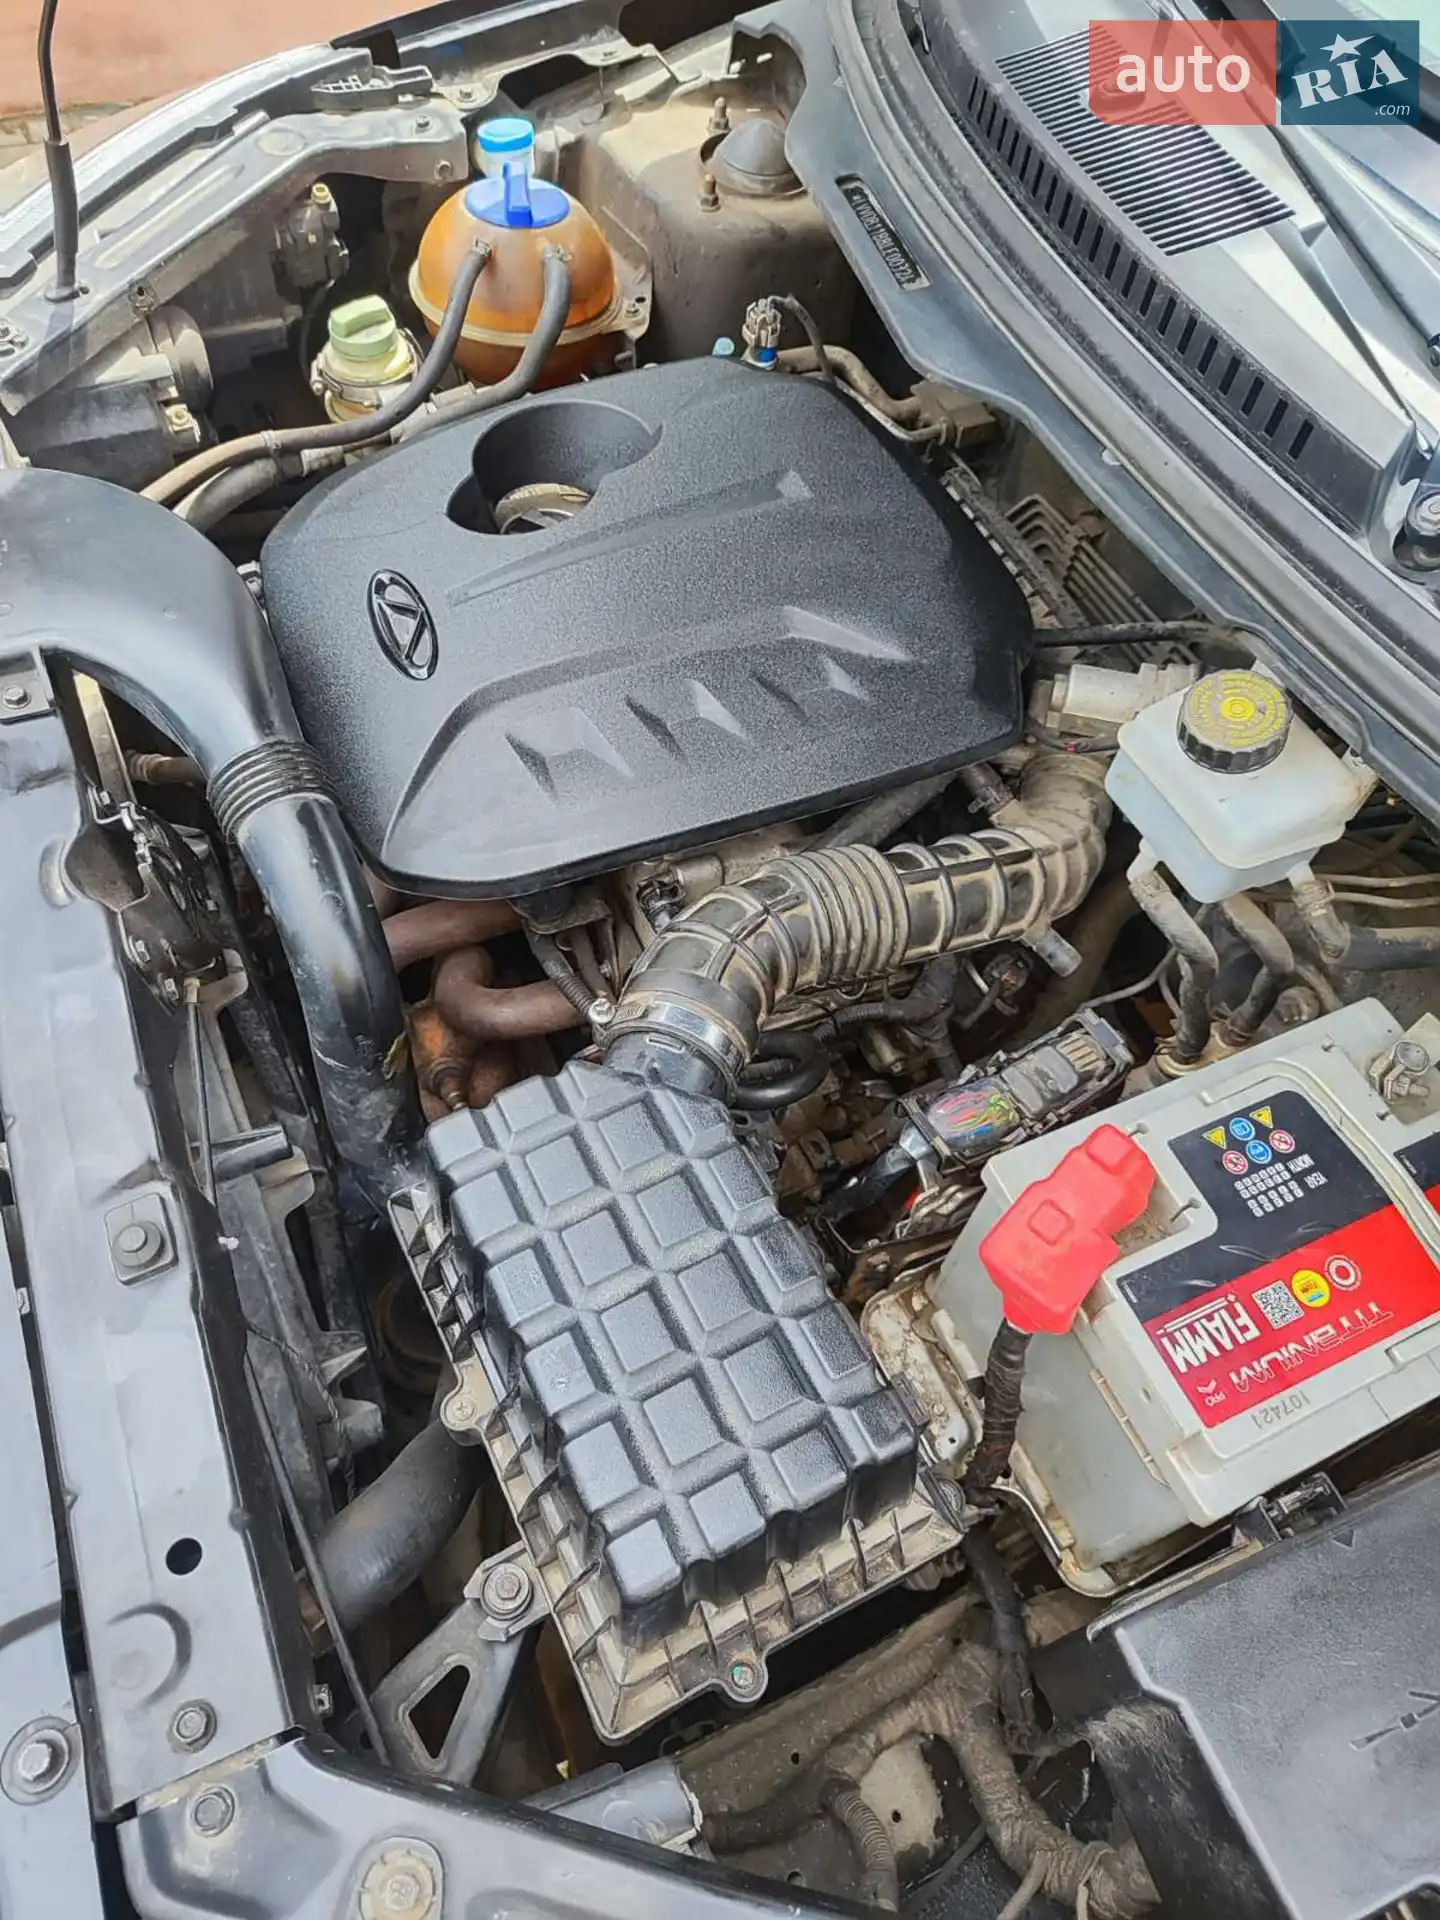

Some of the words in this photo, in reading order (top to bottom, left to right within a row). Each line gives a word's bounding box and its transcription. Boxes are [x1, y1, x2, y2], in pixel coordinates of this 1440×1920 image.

[1303, 1171, 1329, 1190] YEAR
[1160, 1301, 1261, 1374] FIAMM
[1204, 1391, 1227, 1408] PRO
